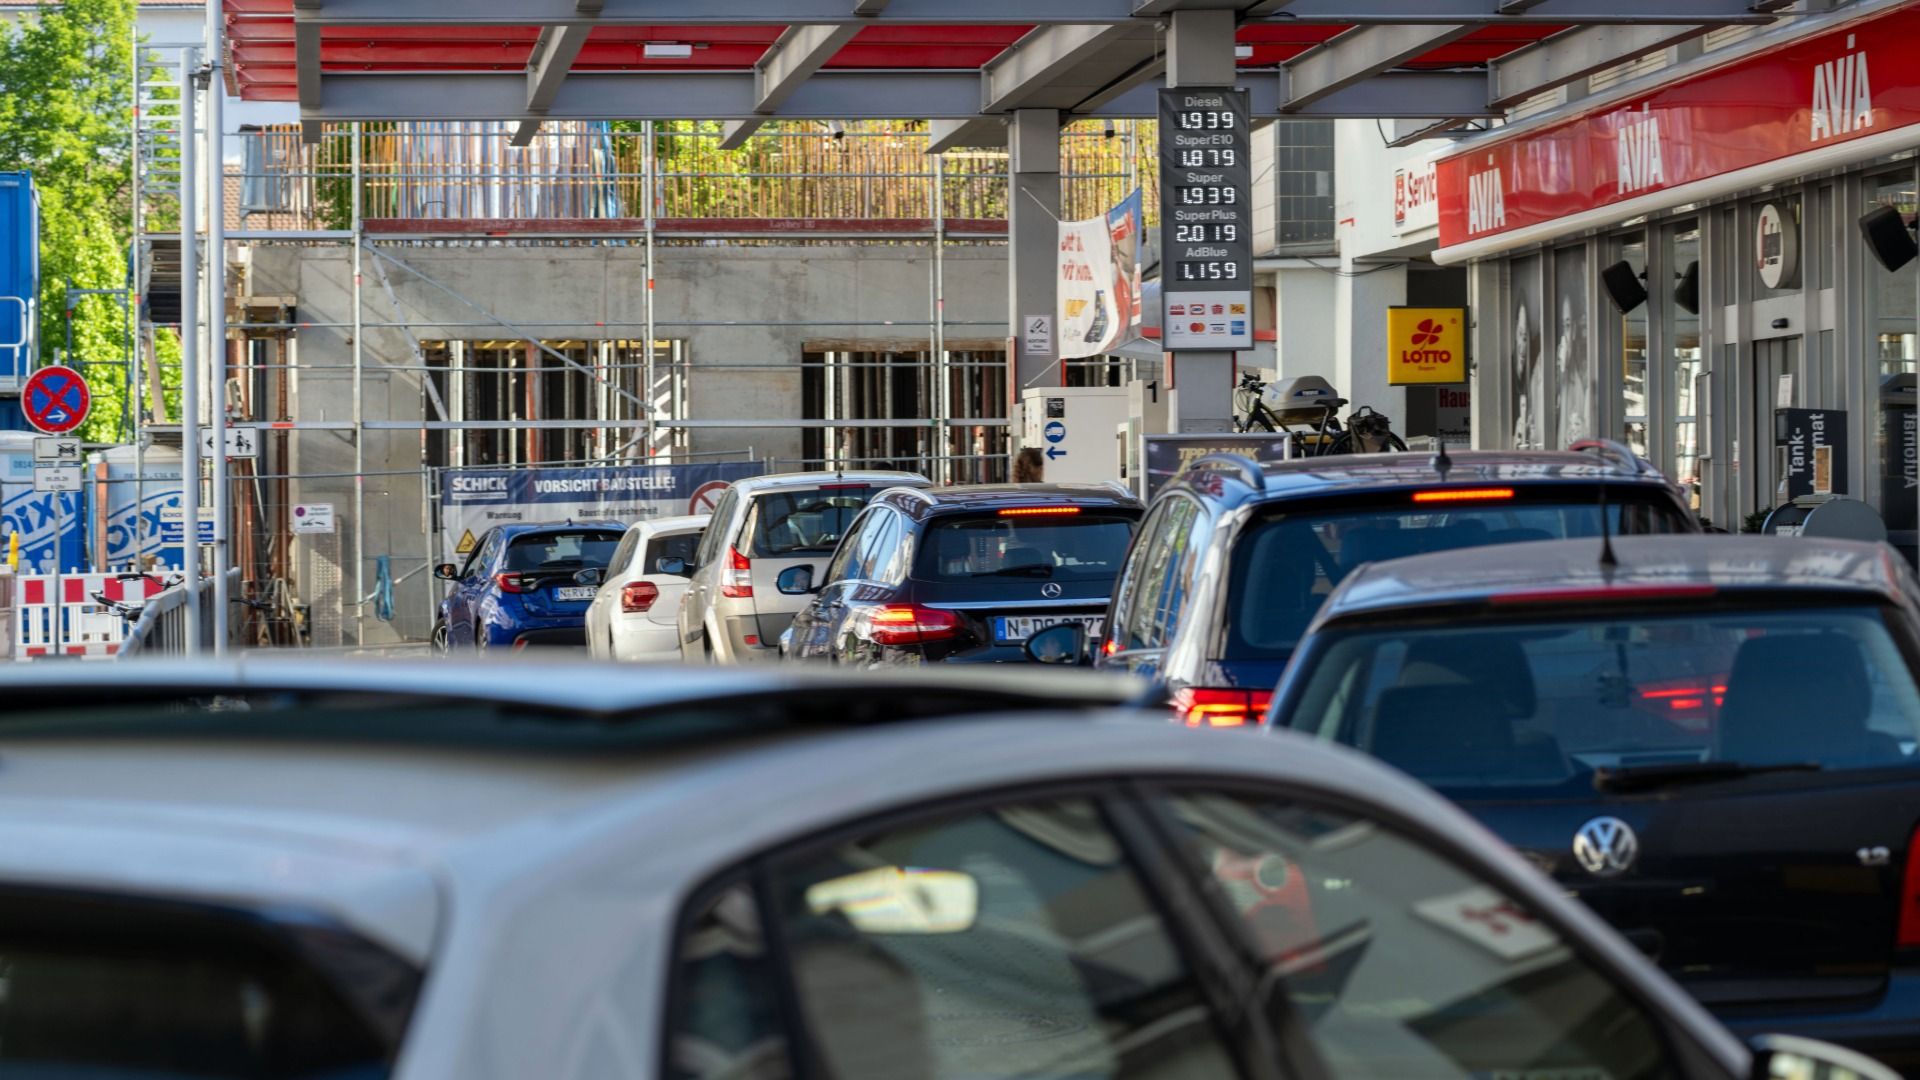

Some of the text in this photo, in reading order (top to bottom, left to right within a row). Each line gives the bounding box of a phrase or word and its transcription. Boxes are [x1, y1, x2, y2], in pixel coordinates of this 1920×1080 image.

[1811, 34, 1872, 142] AVIA
[1185, 96, 1222, 107] Diesel
[1181, 111, 1234, 129] 1.939
[1618, 102, 1664, 195] AVIA
[1182, 149, 1235, 167] 1.879
[1187, 172, 1223, 185] Super
[1183, 187, 1235, 204] 1.939
[1468, 154, 1506, 235] AVIA
[1176, 224, 1236, 243] 2.019
[1185, 246, 1228, 257] AdBlue
[1402, 350, 1452, 363] LOTTO
[1146, 381, 1157, 403] 1
[1788, 427, 1805, 476] Tank-
[452, 477, 508, 491] SCHICK
[534, 476, 676, 493] VORSICHT BAUSTELLE!
[1007, 619, 1019, 637] N
